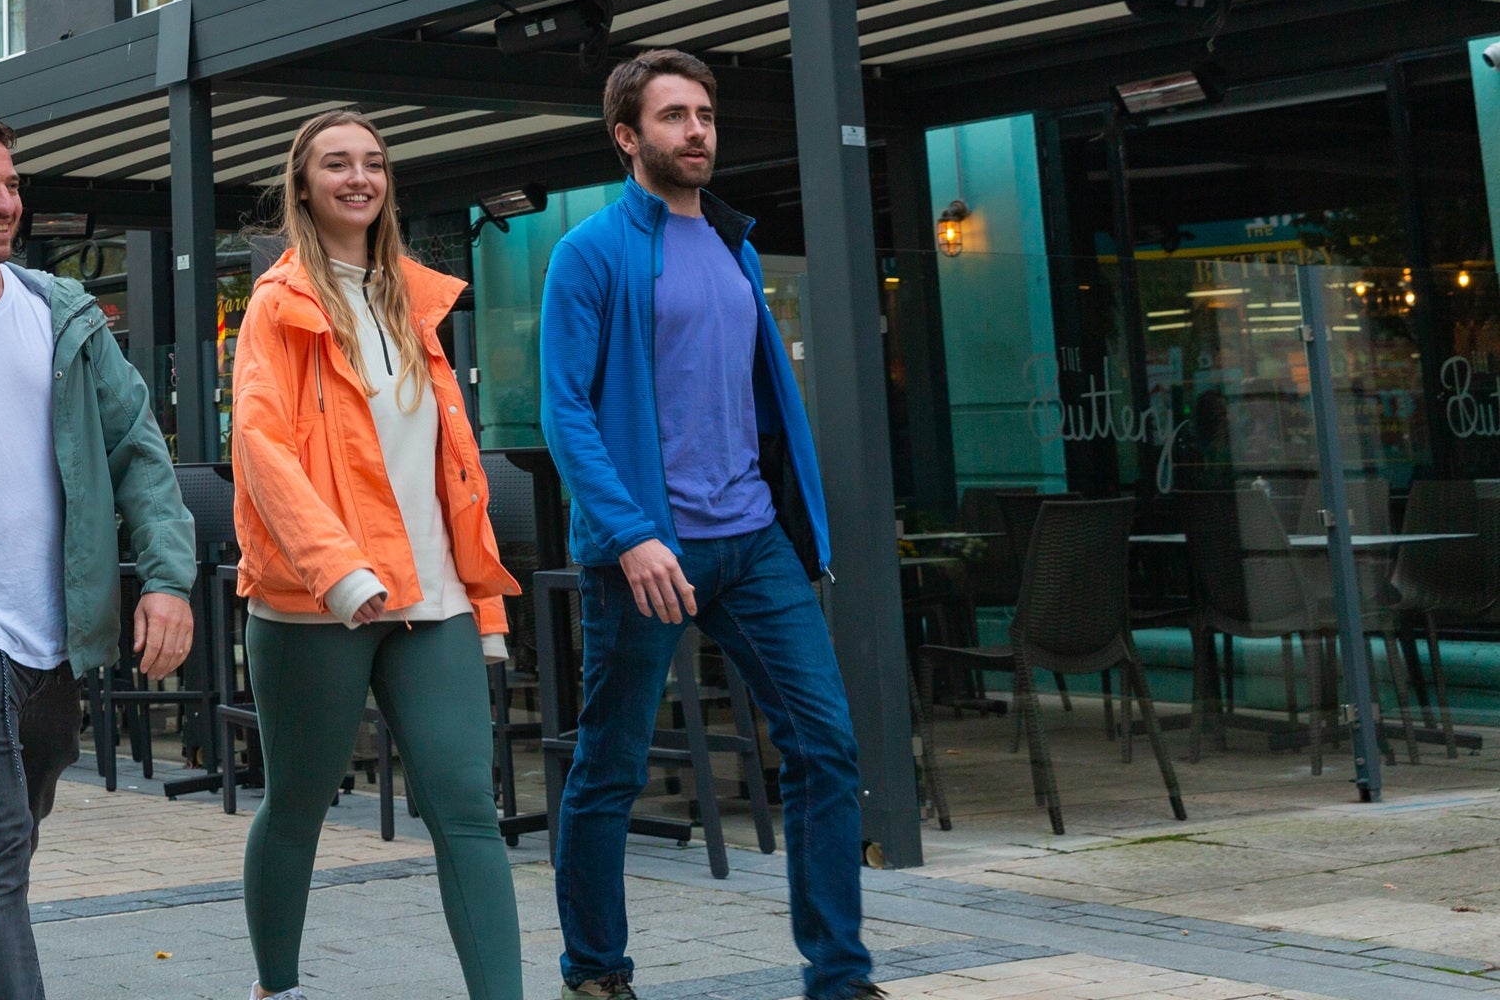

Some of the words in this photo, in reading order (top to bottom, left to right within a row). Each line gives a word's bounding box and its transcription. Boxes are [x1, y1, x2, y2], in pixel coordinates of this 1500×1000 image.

[1245, 225, 1274, 238] THE
[1060, 346, 1082, 373] THE
[1023, 352, 1190, 494] Buttery
